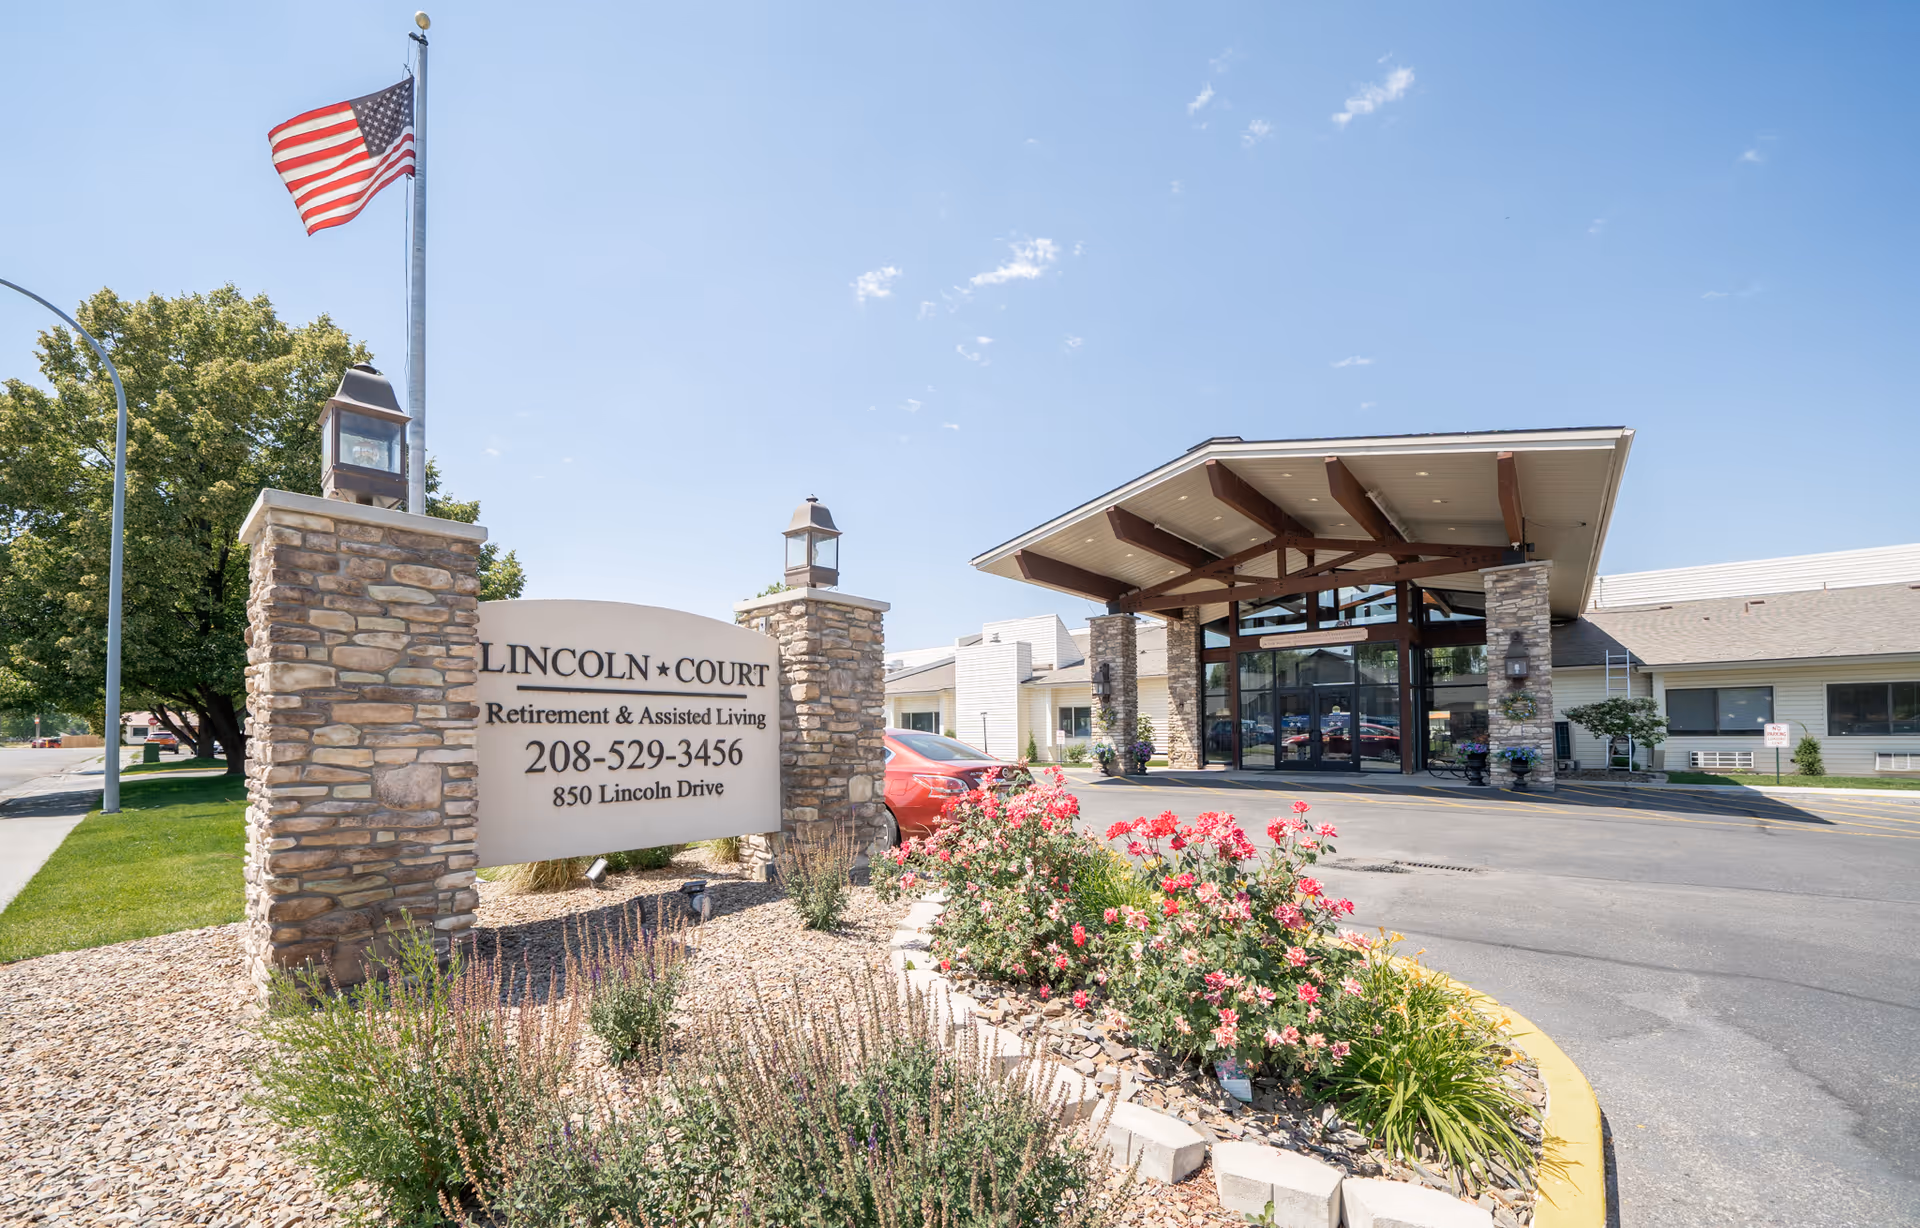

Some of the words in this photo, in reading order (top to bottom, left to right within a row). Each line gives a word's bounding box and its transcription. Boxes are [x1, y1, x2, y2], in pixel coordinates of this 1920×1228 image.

[479, 642, 650, 681] LINCOLN
[676, 657, 769, 687] COURT
[485, 702, 609, 725] Retirement
[615, 705, 633, 725] &
[638, 706, 712, 725] Assisted
[716, 708, 767, 729] Living
[525, 738, 743, 773] 208-529-3456
[552, 786, 593, 808] 850
[599, 780, 672, 804] Lincoln
[677, 779, 724, 798] Drive
